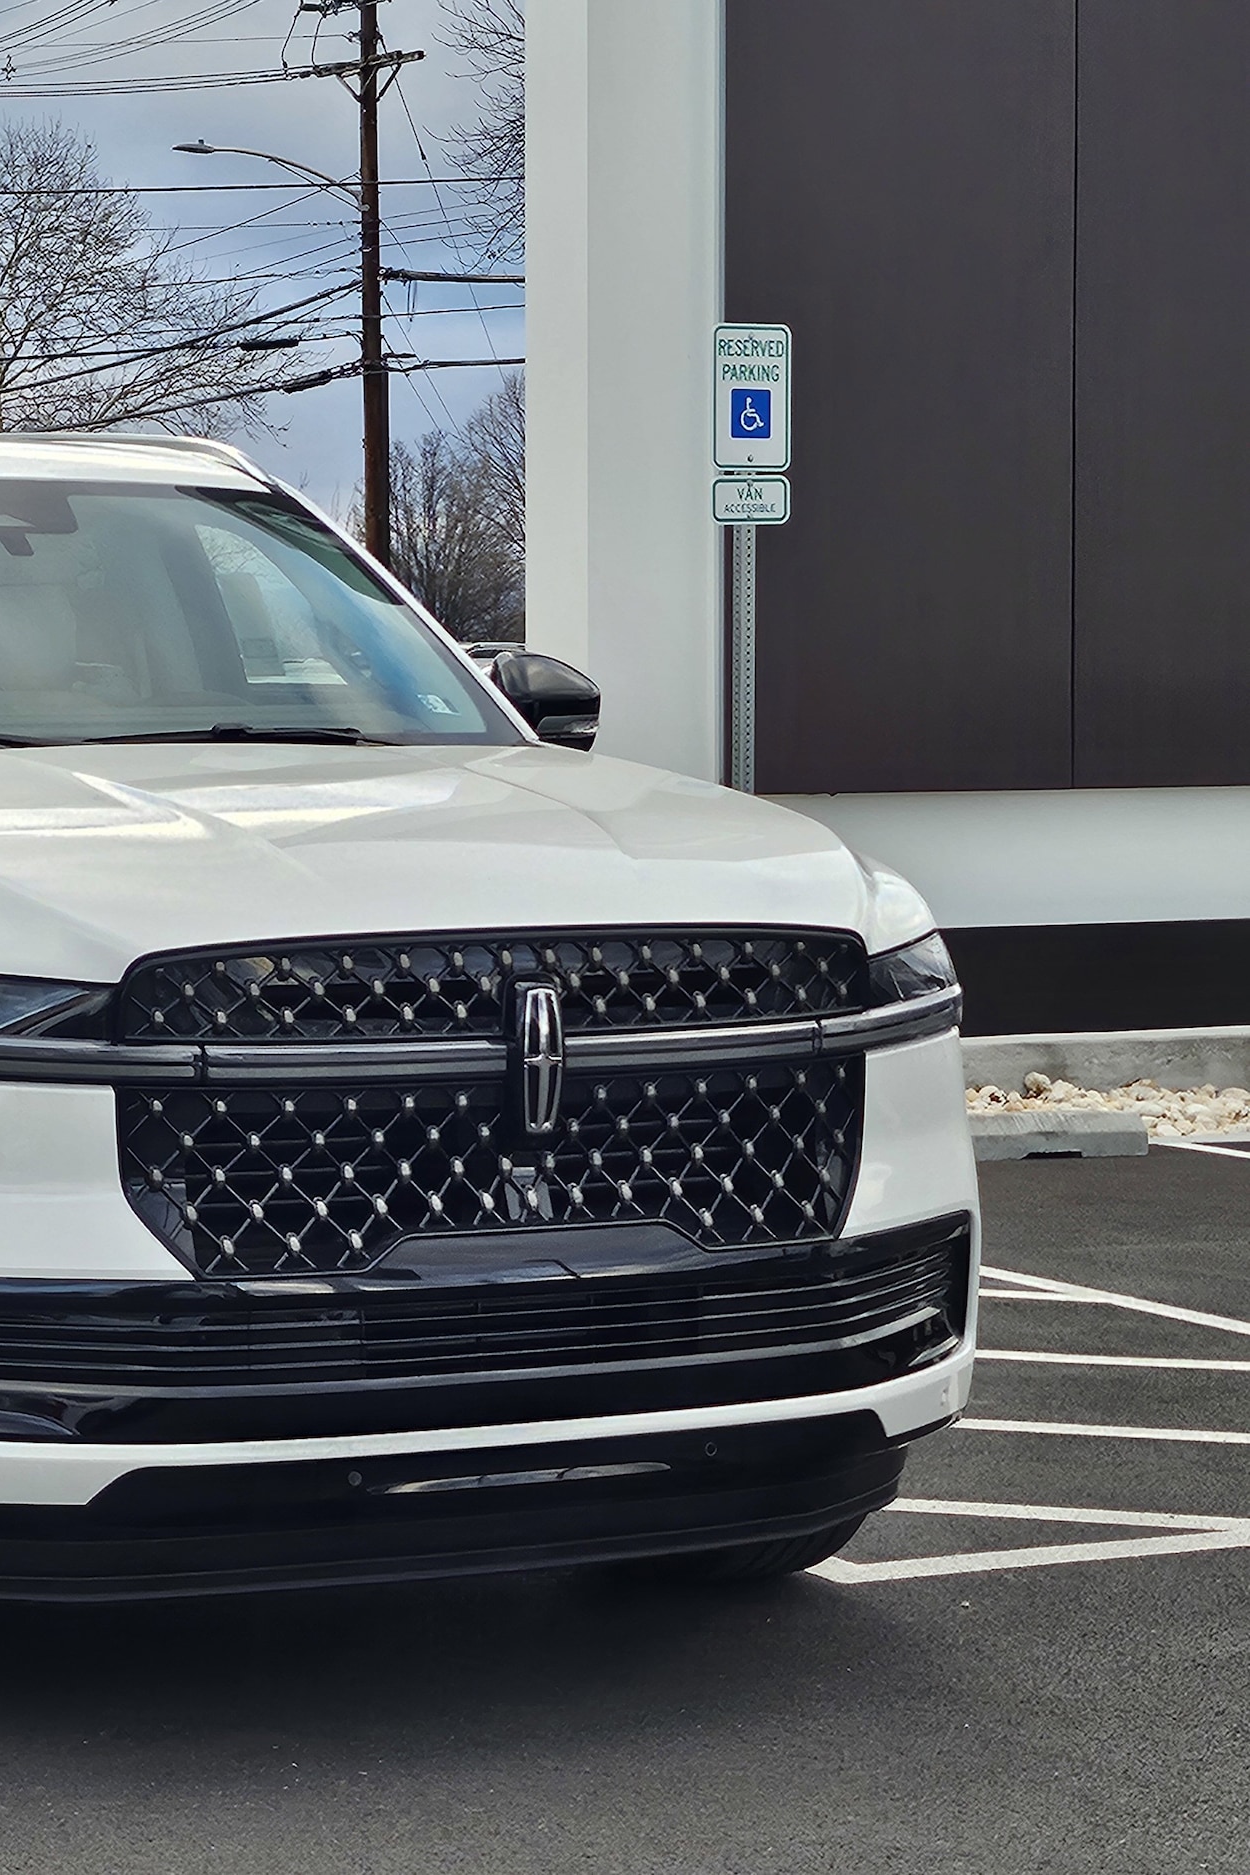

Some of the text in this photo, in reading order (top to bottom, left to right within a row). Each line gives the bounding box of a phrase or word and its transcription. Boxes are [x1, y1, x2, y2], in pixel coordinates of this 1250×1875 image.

[718, 338, 784, 358] RESERVED
[722, 364, 780, 382] PARKING
[737, 488, 763, 501] VAN
[724, 503, 776, 514] ACCESSIBLE
